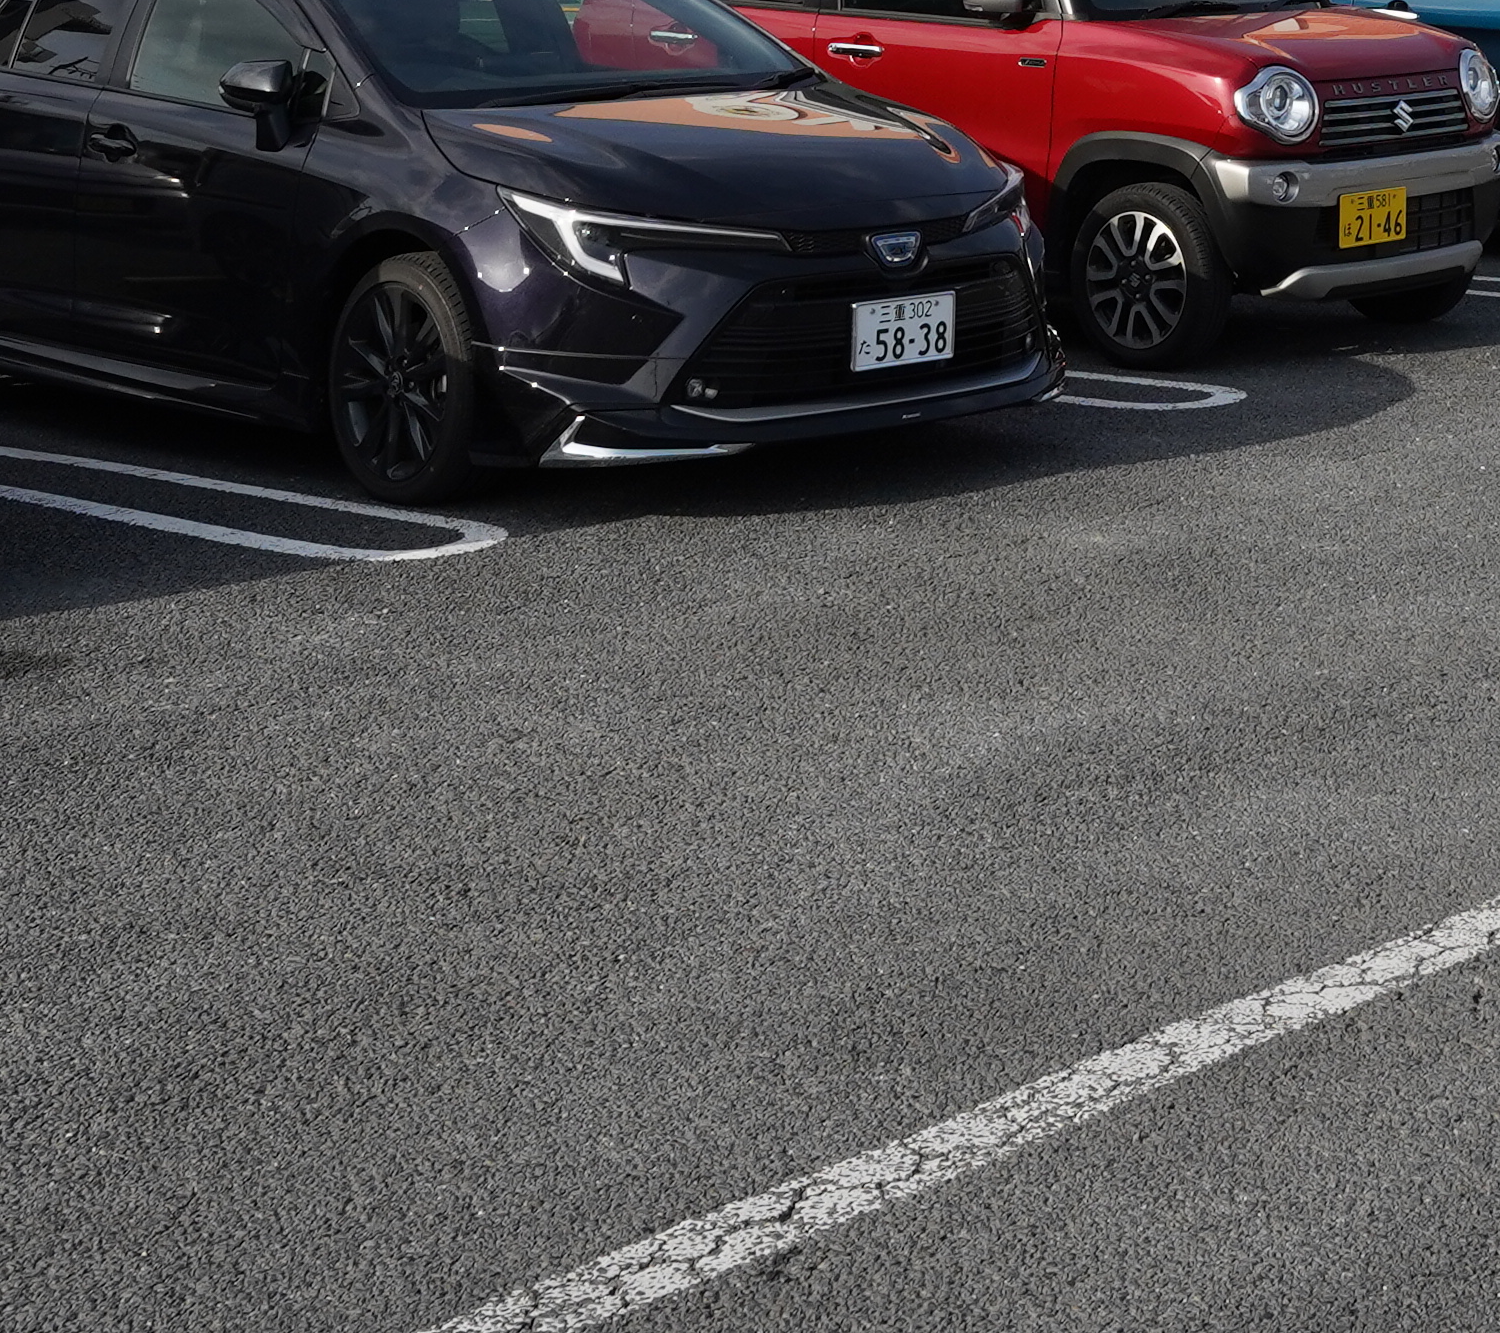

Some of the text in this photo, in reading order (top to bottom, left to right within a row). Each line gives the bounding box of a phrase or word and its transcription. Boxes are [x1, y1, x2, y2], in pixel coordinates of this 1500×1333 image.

[1331, 74, 1451, 96] HUSTLER
[1354, 209, 1404, 243] 21-46
[858, 320, 948, 362] た 58-38
